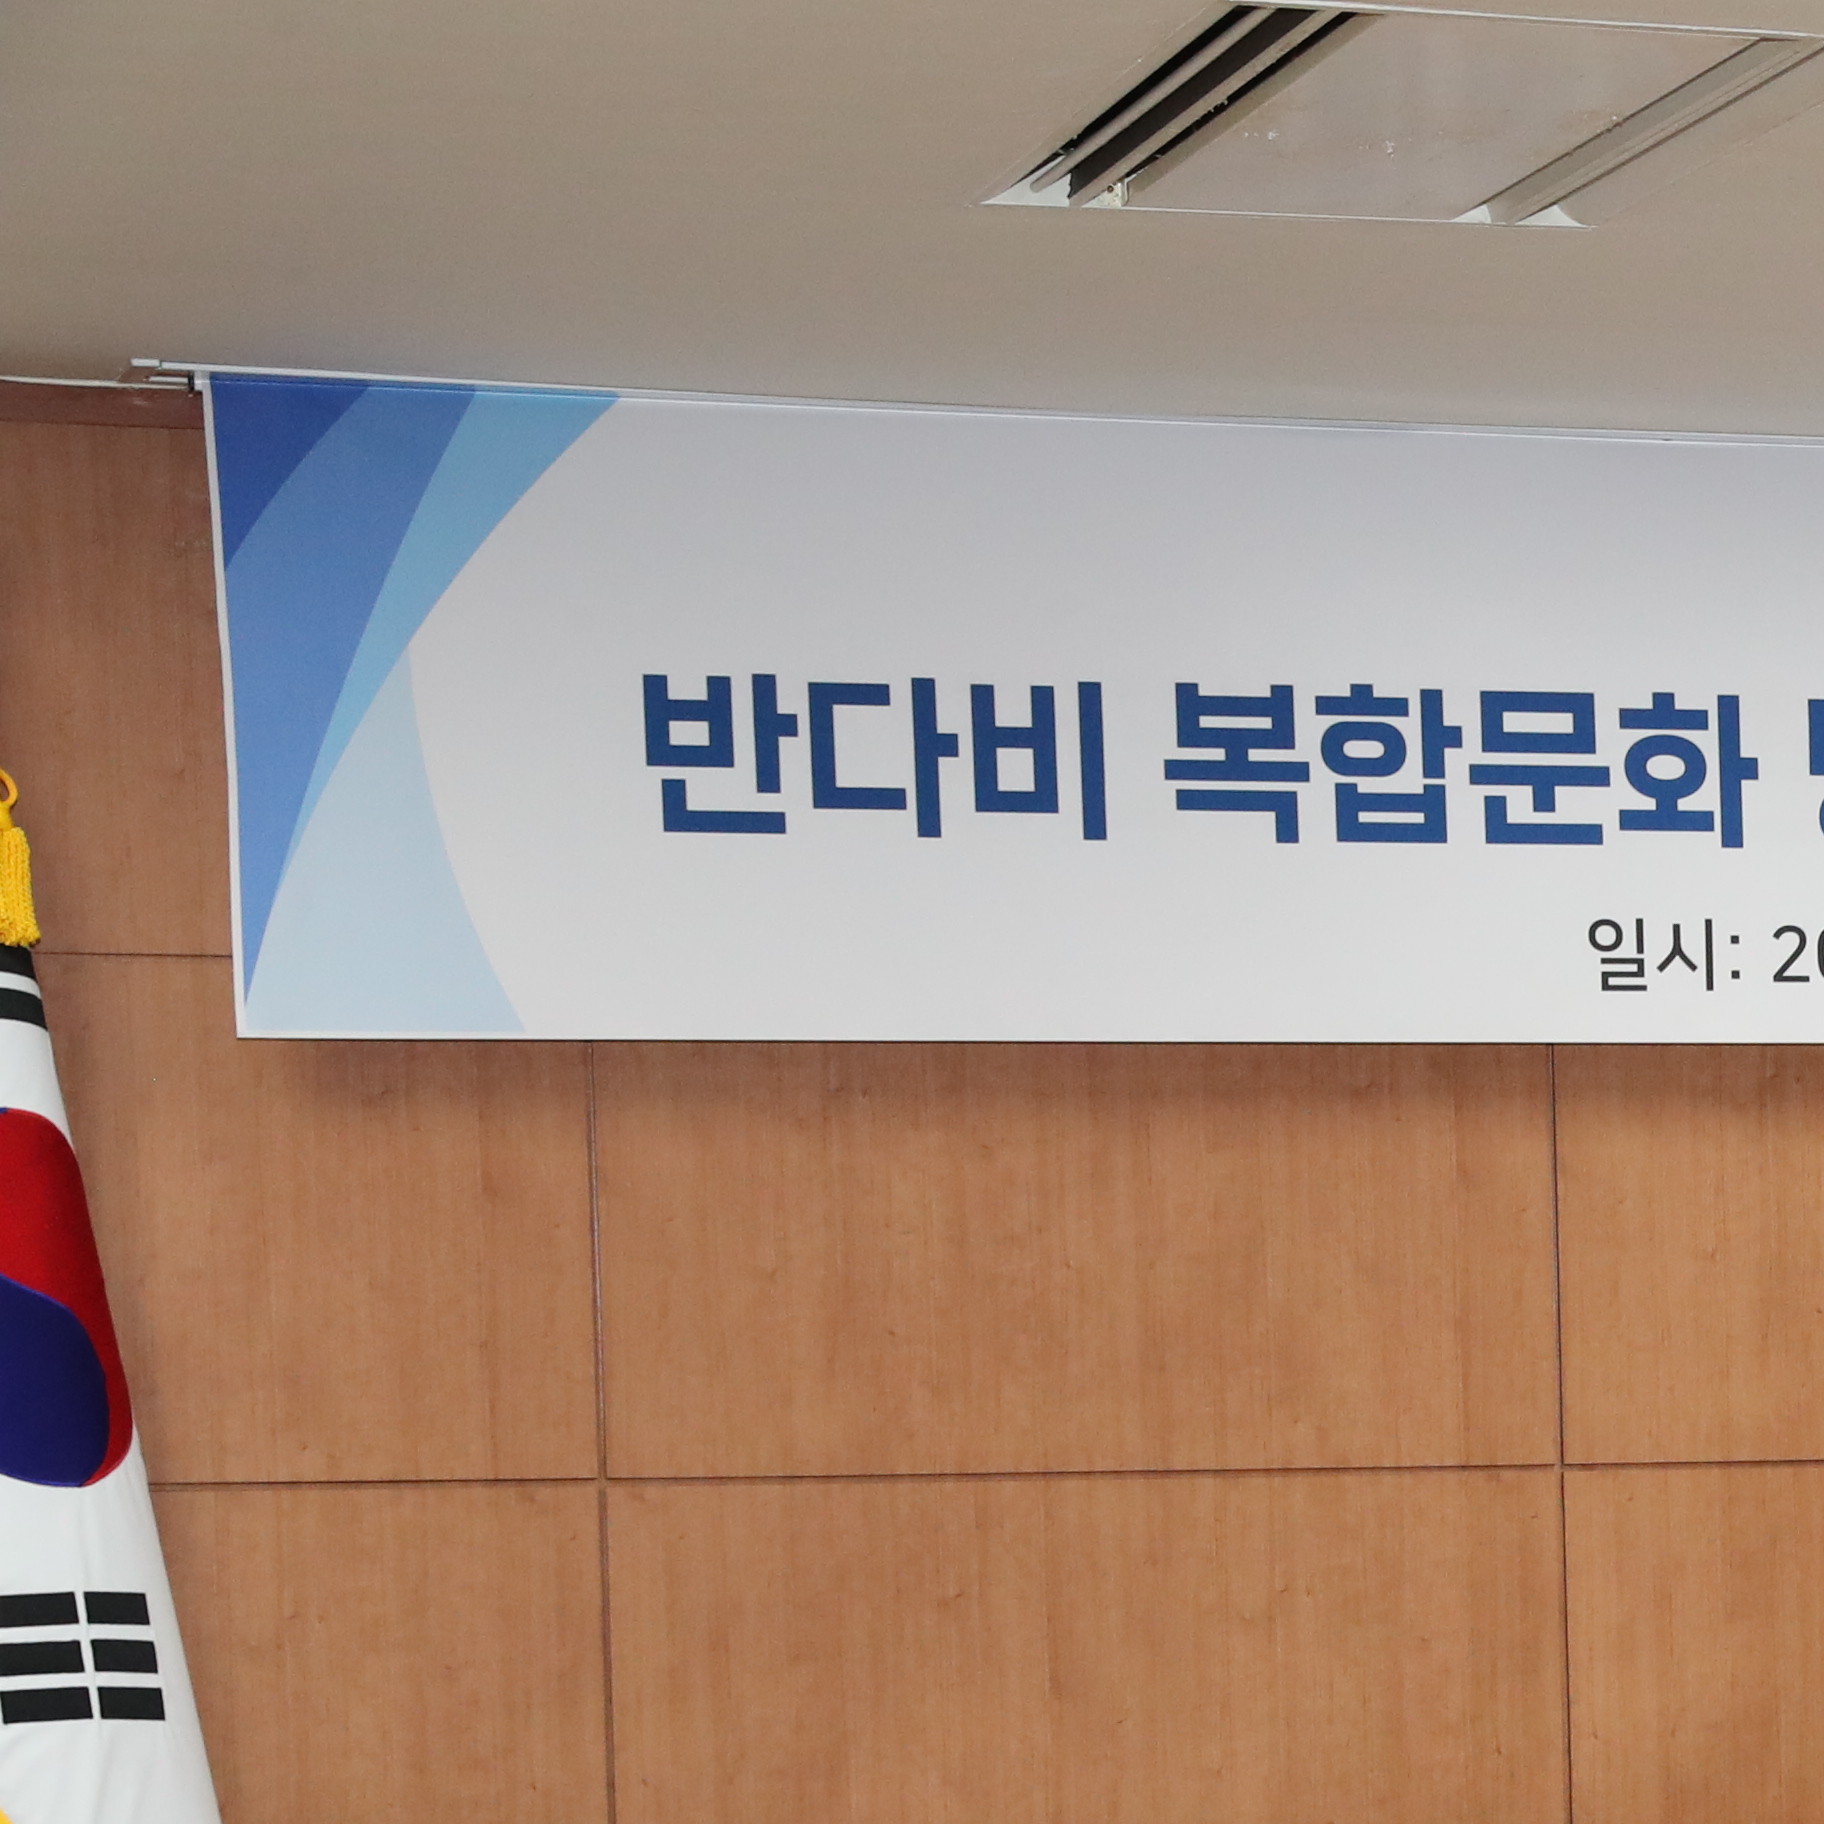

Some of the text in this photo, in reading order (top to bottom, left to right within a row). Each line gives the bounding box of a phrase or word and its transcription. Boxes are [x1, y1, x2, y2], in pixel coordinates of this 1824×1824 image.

[642, 673, 1107, 842] 반다비
[1163, 682, 1759, 850] 복합문화
[1588, 918, 1741, 993] 일시:
